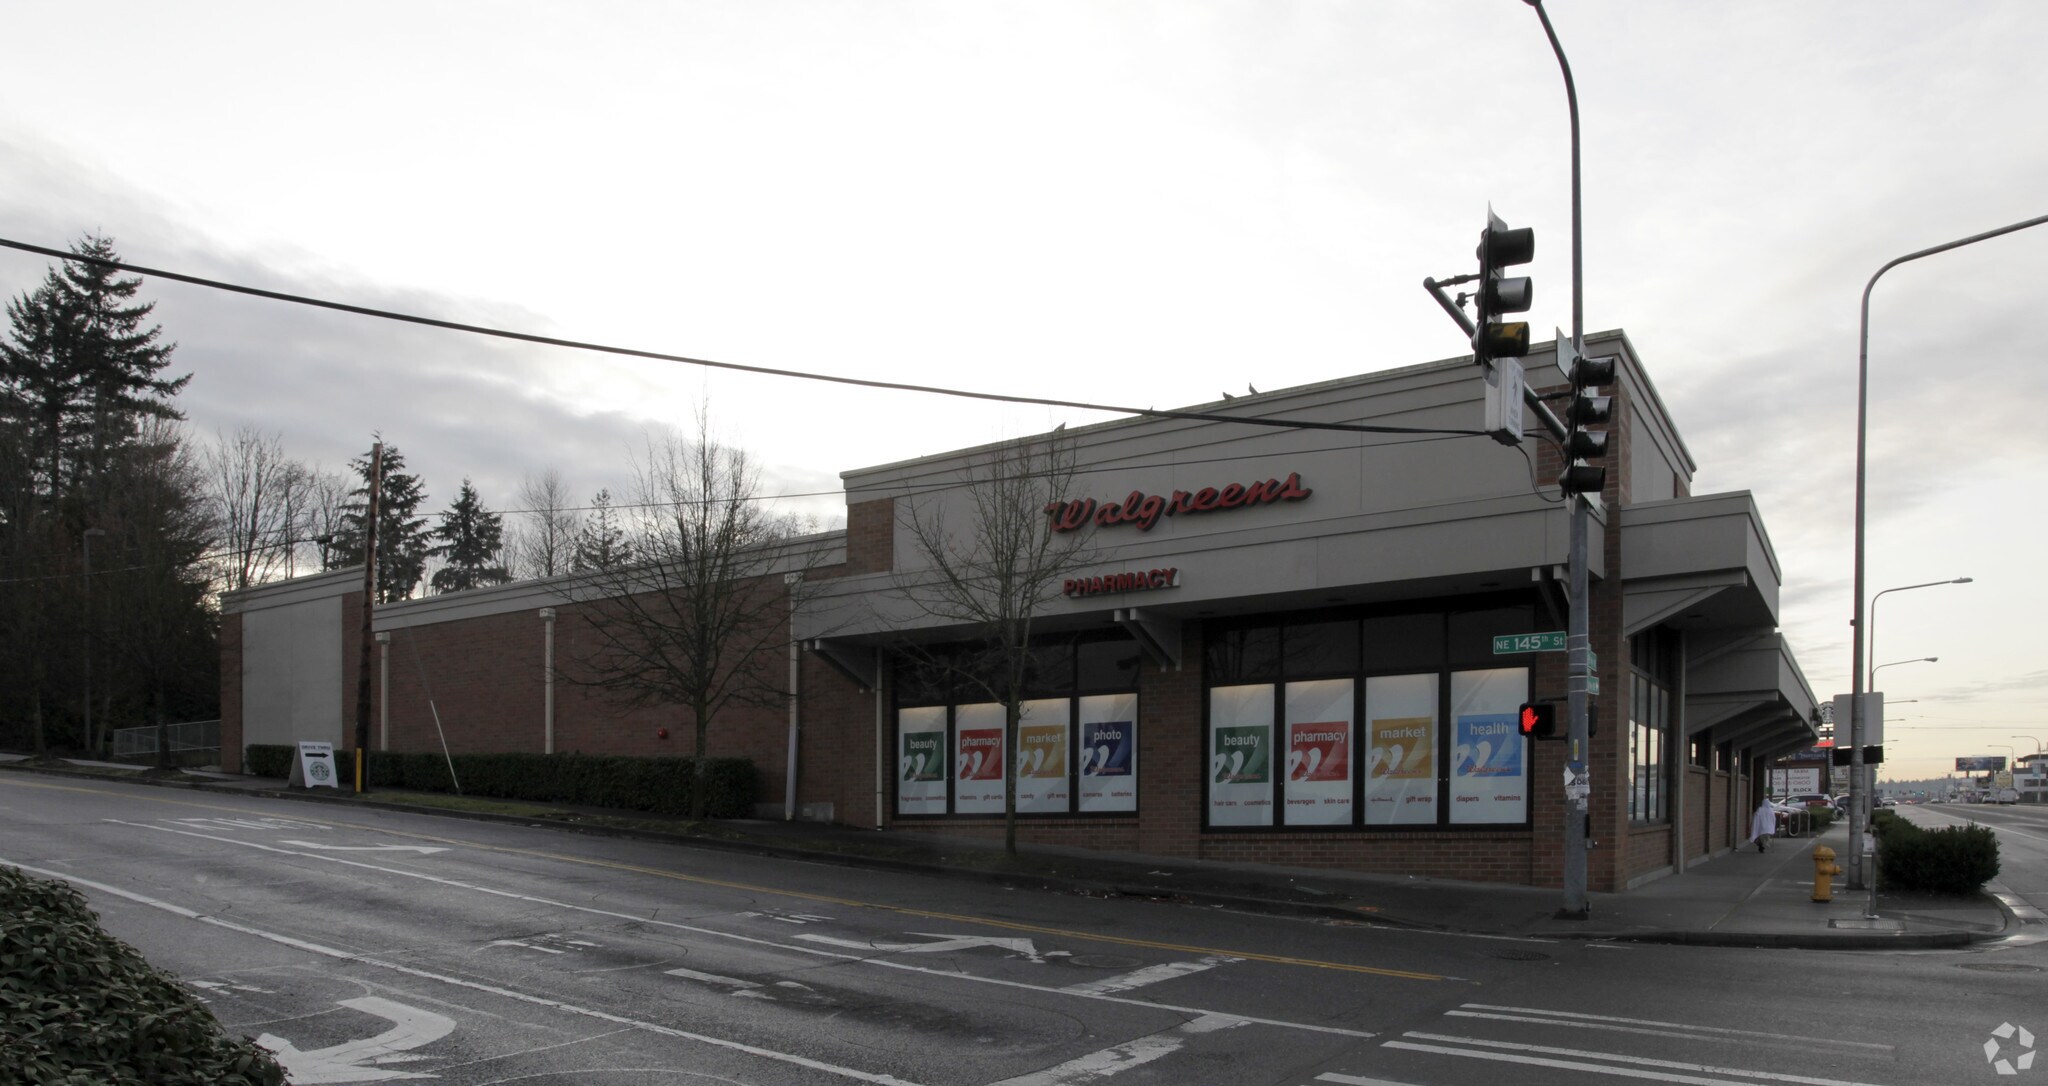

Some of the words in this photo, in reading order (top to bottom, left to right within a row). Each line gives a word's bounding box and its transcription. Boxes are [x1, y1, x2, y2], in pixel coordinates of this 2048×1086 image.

[1044, 472, 1312, 532] Walgreens
[1064, 568, 1178, 595] PHARMACY
[1496, 640, 1510, 650] NE
[1514, 635, 1549, 650] 145th
[1553, 636, 1564, 646] St
[1380, 726, 1426, 739] market
[1470, 722, 1509, 735] health
[1027, 732, 1062, 744] market
[1093, 729, 1122, 742] photo
[1224, 734, 1260, 748] beauty
[1294, 731, 1346, 745] pharmacy
[909, 739, 938, 750] beauty
[961, 737, 1001, 749] pharmacy
[1493, 794, 1521, 802] vitamins
